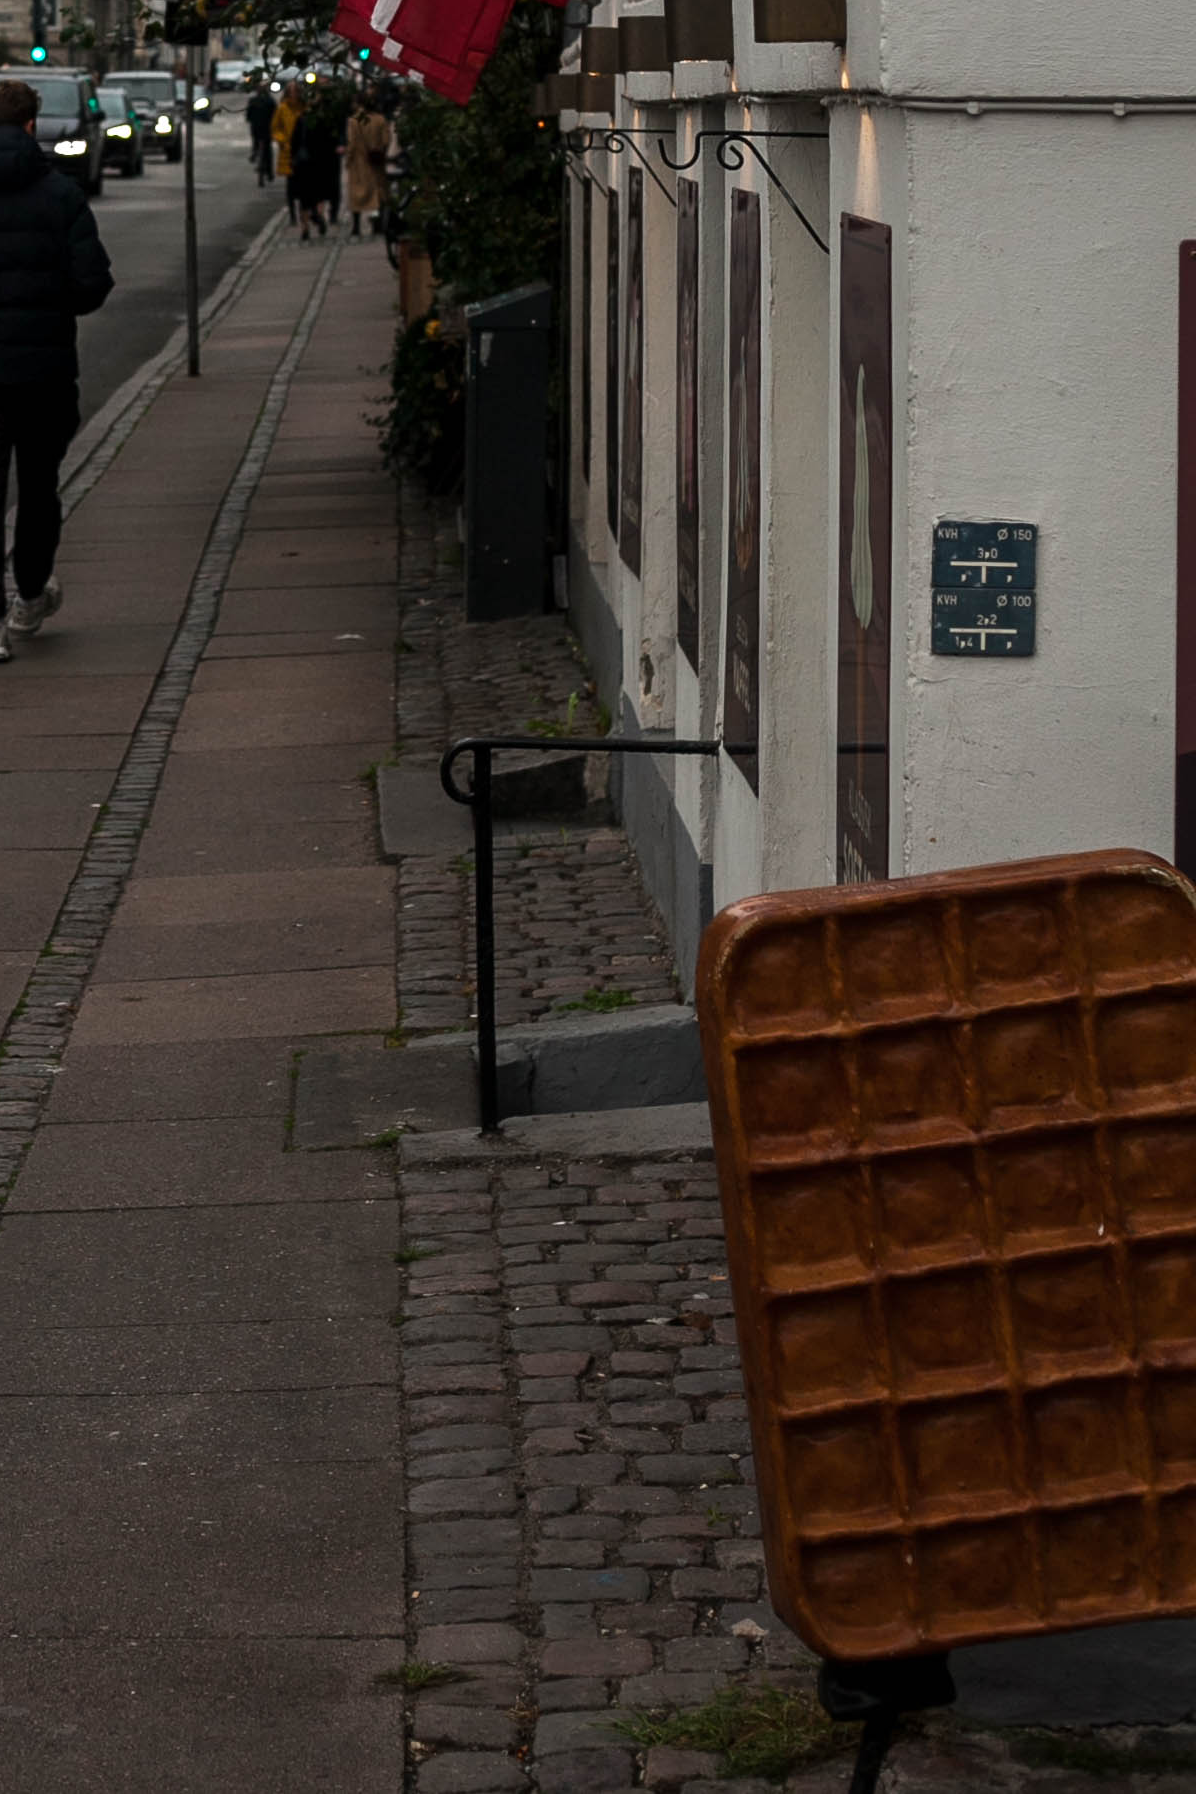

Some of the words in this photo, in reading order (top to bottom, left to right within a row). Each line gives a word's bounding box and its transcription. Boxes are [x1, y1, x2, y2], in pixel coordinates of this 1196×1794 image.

[937, 527, 958, 539] KVH
[1013, 529, 1033, 541] 150
[977, 547, 998, 560] 3,0
[936, 594, 958, 605] KVH
[1012, 595, 1032, 607] 100
[976, 614, 998, 626] 2,2
[955, 636, 973, 649] 1,4
